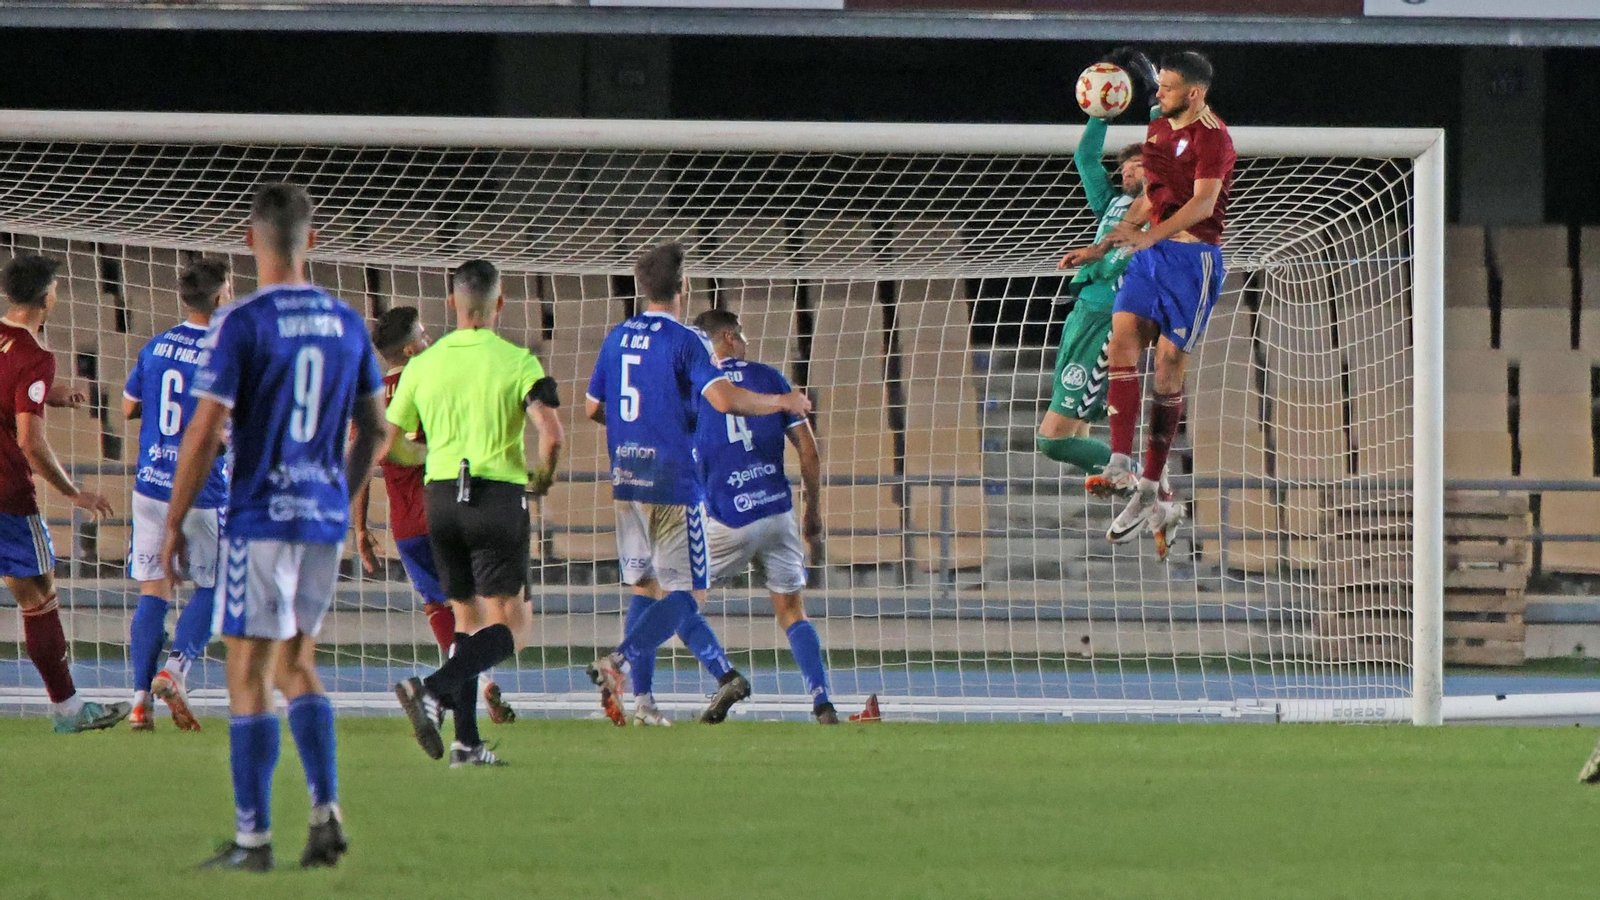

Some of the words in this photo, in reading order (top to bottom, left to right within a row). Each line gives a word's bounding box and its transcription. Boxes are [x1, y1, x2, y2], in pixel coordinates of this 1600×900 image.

[174, 346, 202, 365] PAREJ
[619, 353, 642, 423] 5
[724, 370, 743, 382] GO
[158, 368, 184, 437] 6
[289, 346, 324, 443] 9
[725, 413, 753, 452] 4
[138, 554, 162, 564] EYE
[622, 557, 646, 568] YES
